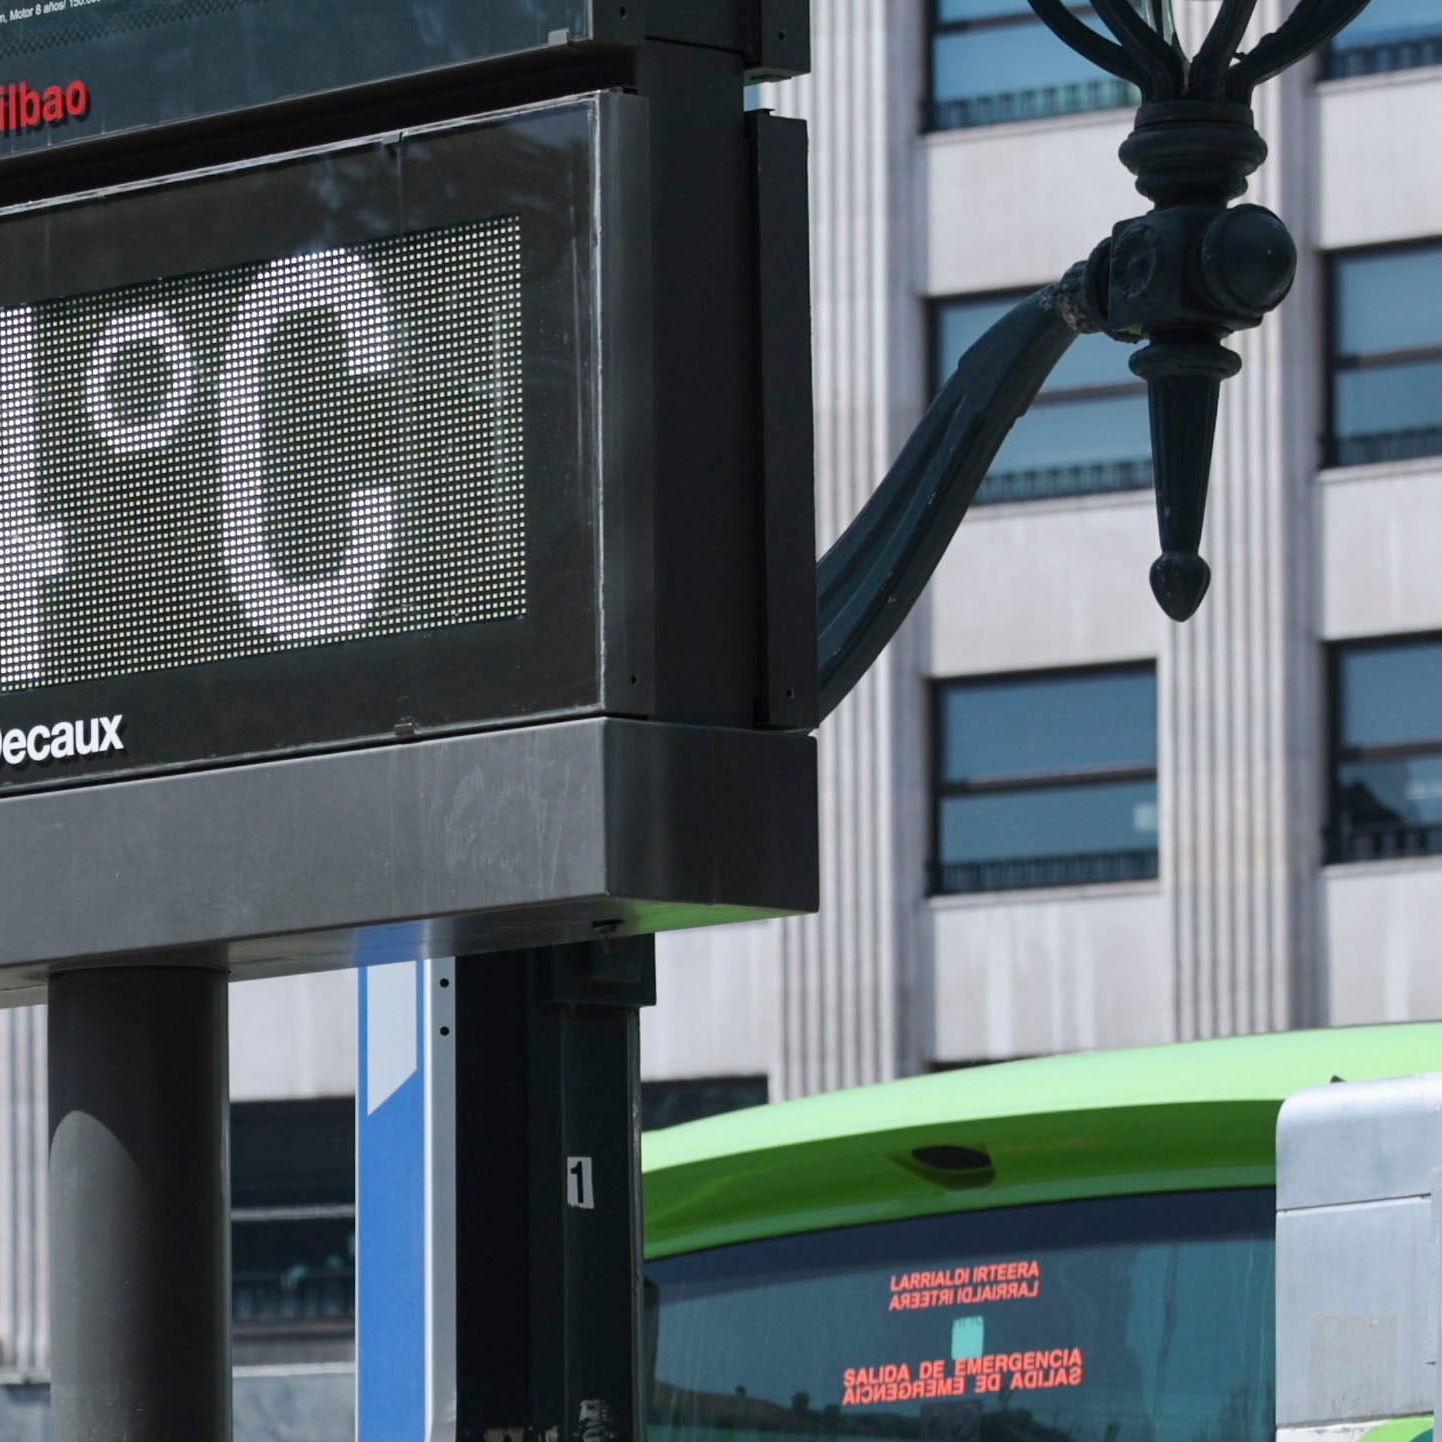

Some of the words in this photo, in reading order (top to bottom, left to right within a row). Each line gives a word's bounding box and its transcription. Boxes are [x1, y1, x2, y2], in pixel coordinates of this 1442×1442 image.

[10, 8, 34, 21] Motor
[35, 4, 41, 15] 8
[570, 1160, 584, 1204] 1
[889, 1268, 969, 1292] LARRIALDI
[973, 1261, 1040, 1283] IRTEERA
[843, 1363, 910, 1387] SALIDA
[919, 1360, 945, 1380] DE
[955, 1348, 1083, 1375] EMERGENCIA
